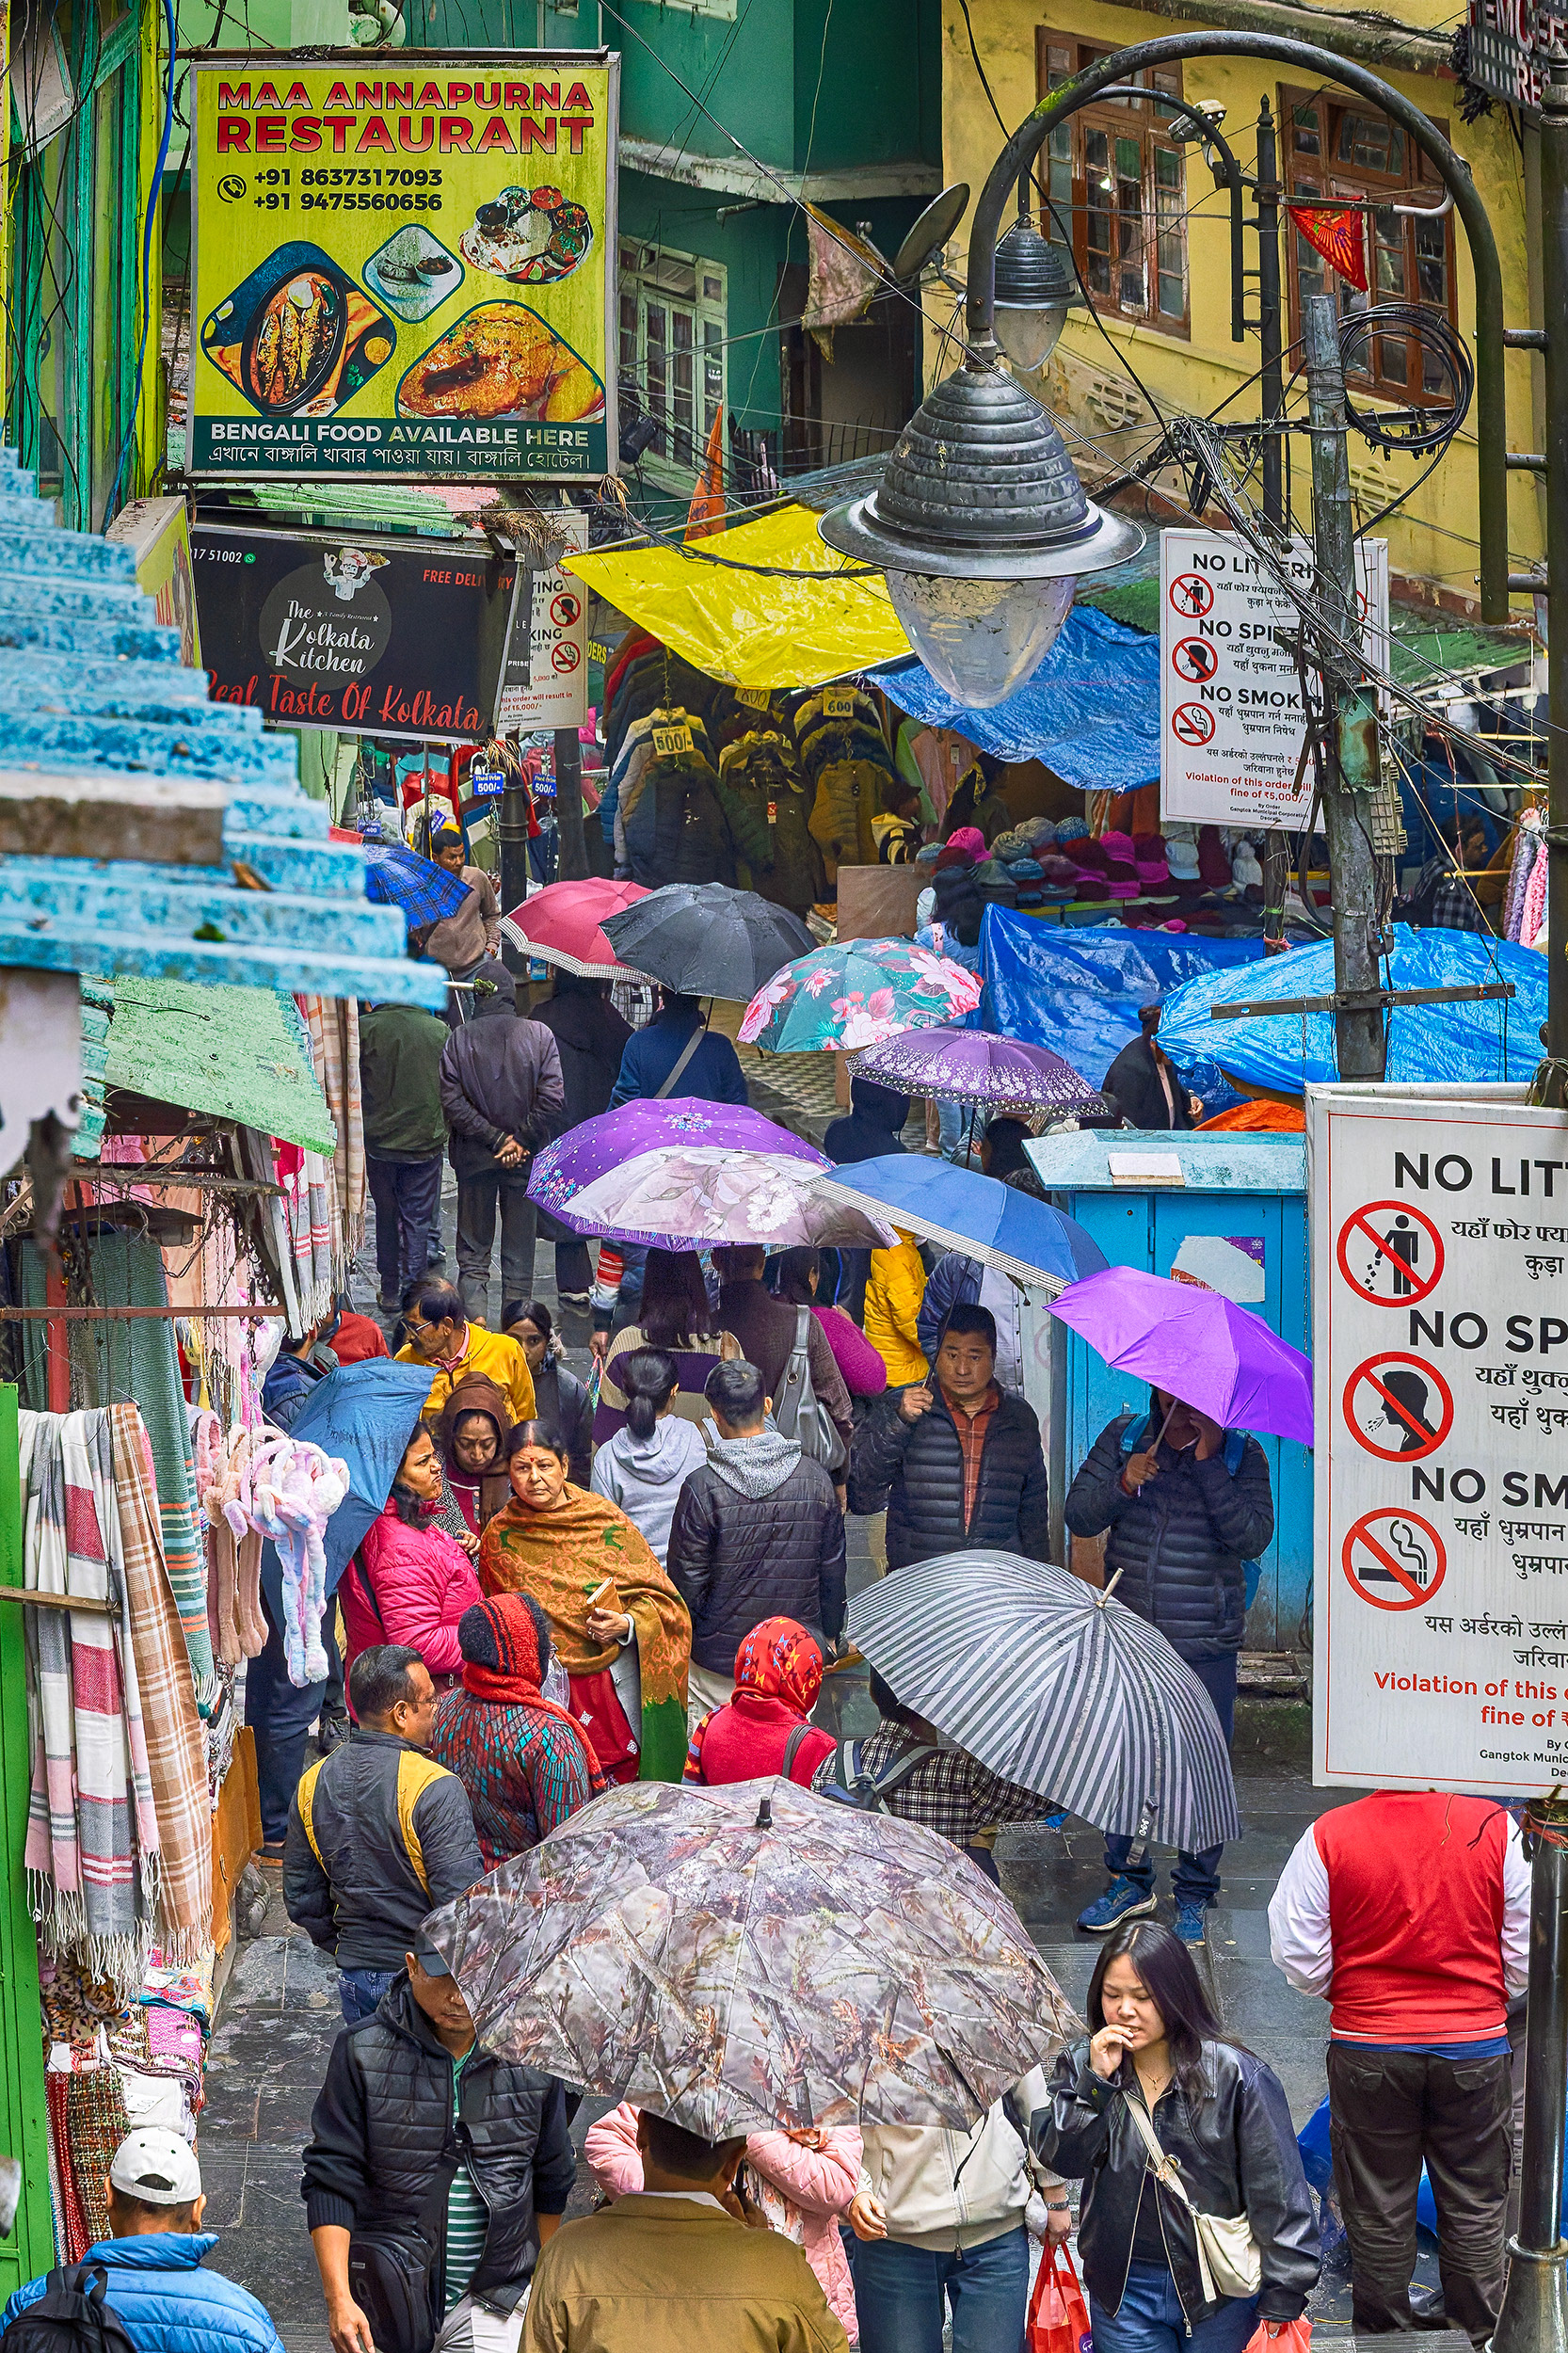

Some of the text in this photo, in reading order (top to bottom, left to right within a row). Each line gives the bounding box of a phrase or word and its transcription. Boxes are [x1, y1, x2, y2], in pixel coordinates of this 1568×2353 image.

[217, 82, 594, 110] MAA ANNAPURNA
[216, 116, 594, 154] RESTAURANT
[254, 168, 442, 186] +91 8637317093
[254, 193, 442, 211] +91 9475560656
[211, 424, 588, 447] BENGALI FOOD AVAILABLE HERE
[209, 446, 260, 461] এখানে
[264, 443, 318, 462] বাঙ্গালি
[323, 448, 367, 463] খাবার
[373, 449, 421, 464] পাওয়া
[466, 447, 521, 466] বাঙ্গালি
[190, 548, 242, 563] 17 51002
[1192, 553, 1225, 571] NO
[423, 569, 513, 590] FREE DELIRY
[288, 600, 313, 618] The
[274, 618, 376, 653] Kolkata
[1199, 619, 1232, 637] NO
[269, 647, 367, 674] Kitchen
[1233, 658, 1249, 671] यहाँ
[269, 674, 334, 715] Taste
[342, 682, 372, 720] Of
[378, 685, 485, 730] Kolkata
[1200, 684, 1232, 702] NO
[827, 701, 852, 713] 600
[477, 782, 500, 793] 500/-
[535, 783, 554, 794] 500/-
[1186, 772, 1229, 784] Violation
[1231, 776, 1241, 785] of
[1244, 777, 1262, 787] this
[1265, 780, 1292, 790] order
[1230, 788, 1249, 797] fine
[1395, 1152, 1568, 1197] NO LIT
[1451, 1217, 1490, 1239] यहाँ
[1493, 1219, 1531, 1240] फोर
[1524, 1255, 1565, 1280] कुड़ा
[1410, 1309, 1568, 1354] NO SP
[1475, 1363, 1518, 1386] यहाँ
[1490, 1398, 1529, 1430] यहाँ
[1412, 1465, 1568, 1510] NO SM
[1453, 1511, 1566, 1546] यहाँ धुम्रपान
[1424, 1615, 1454, 1634] यस
[1459, 1611, 1524, 1638] अर्डरको
[1374, 1672, 1558, 1700] Violation of this
[1480, 1705, 1525, 1726] fine
[1531, 1709, 1556, 1728] of
[1480, 1749, 1529, 1764] Gangtok
[1546, 1739, 1561, 1752] By
